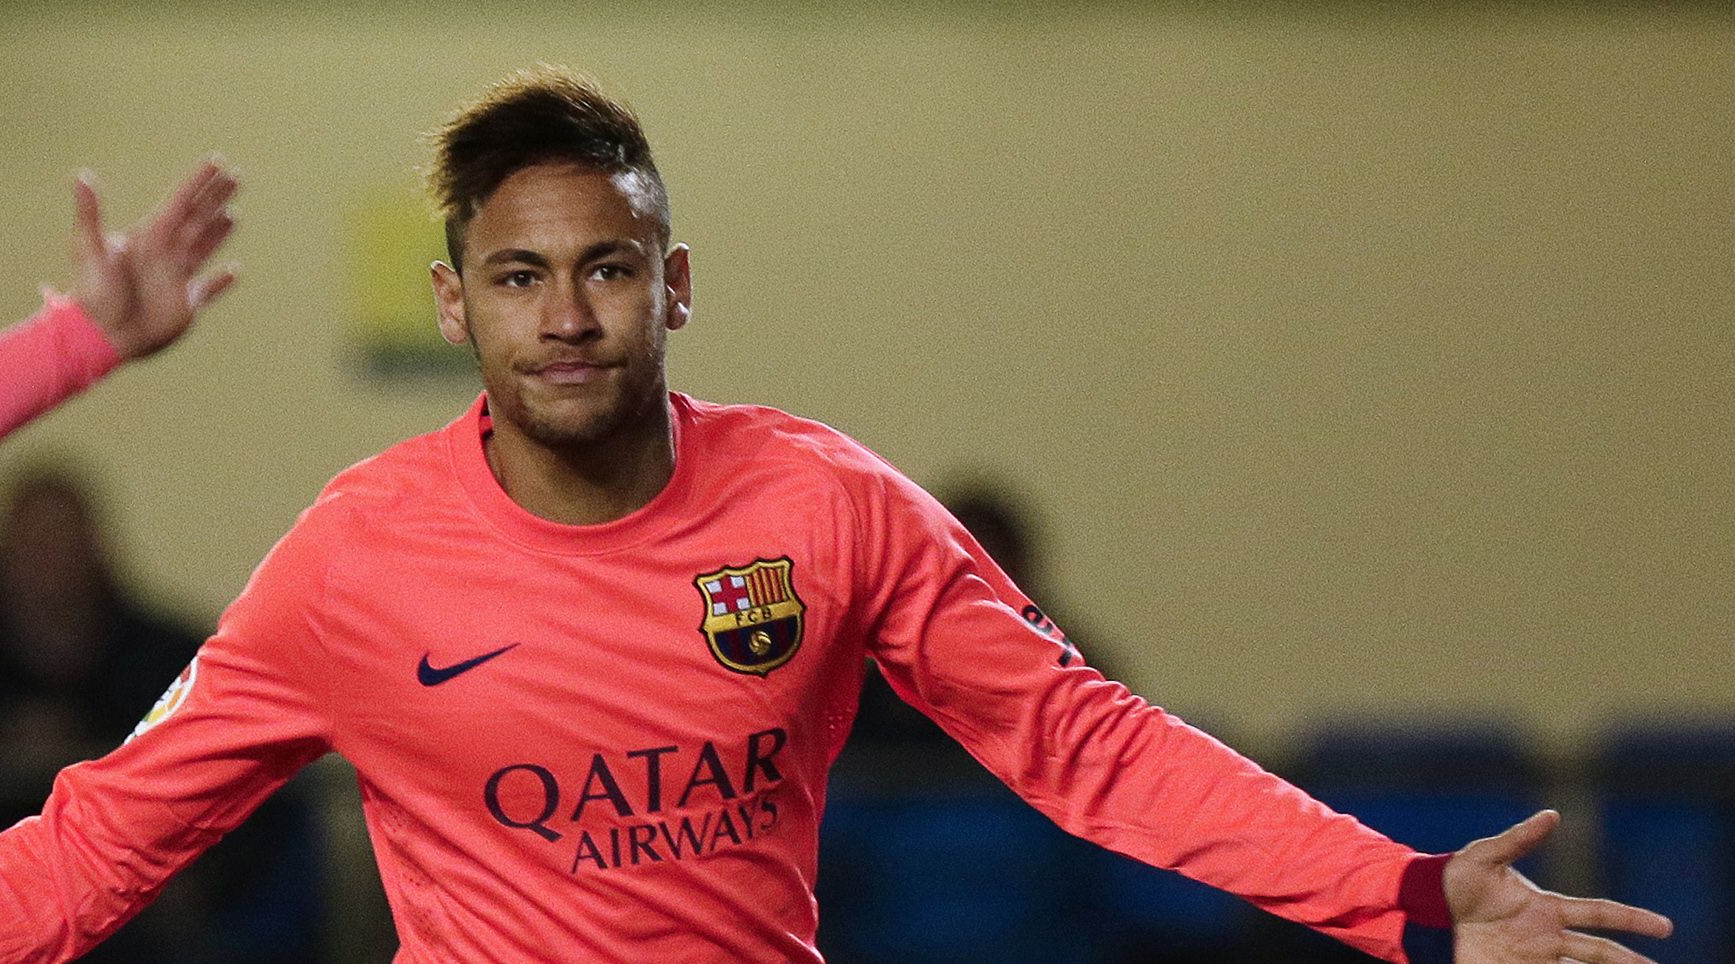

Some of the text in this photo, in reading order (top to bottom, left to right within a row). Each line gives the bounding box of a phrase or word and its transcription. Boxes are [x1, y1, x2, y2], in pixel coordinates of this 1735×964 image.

[734, 606, 772, 627] FCB
[484, 728, 788, 841] QATAR
[571, 802, 778, 874] AIRWAYS
